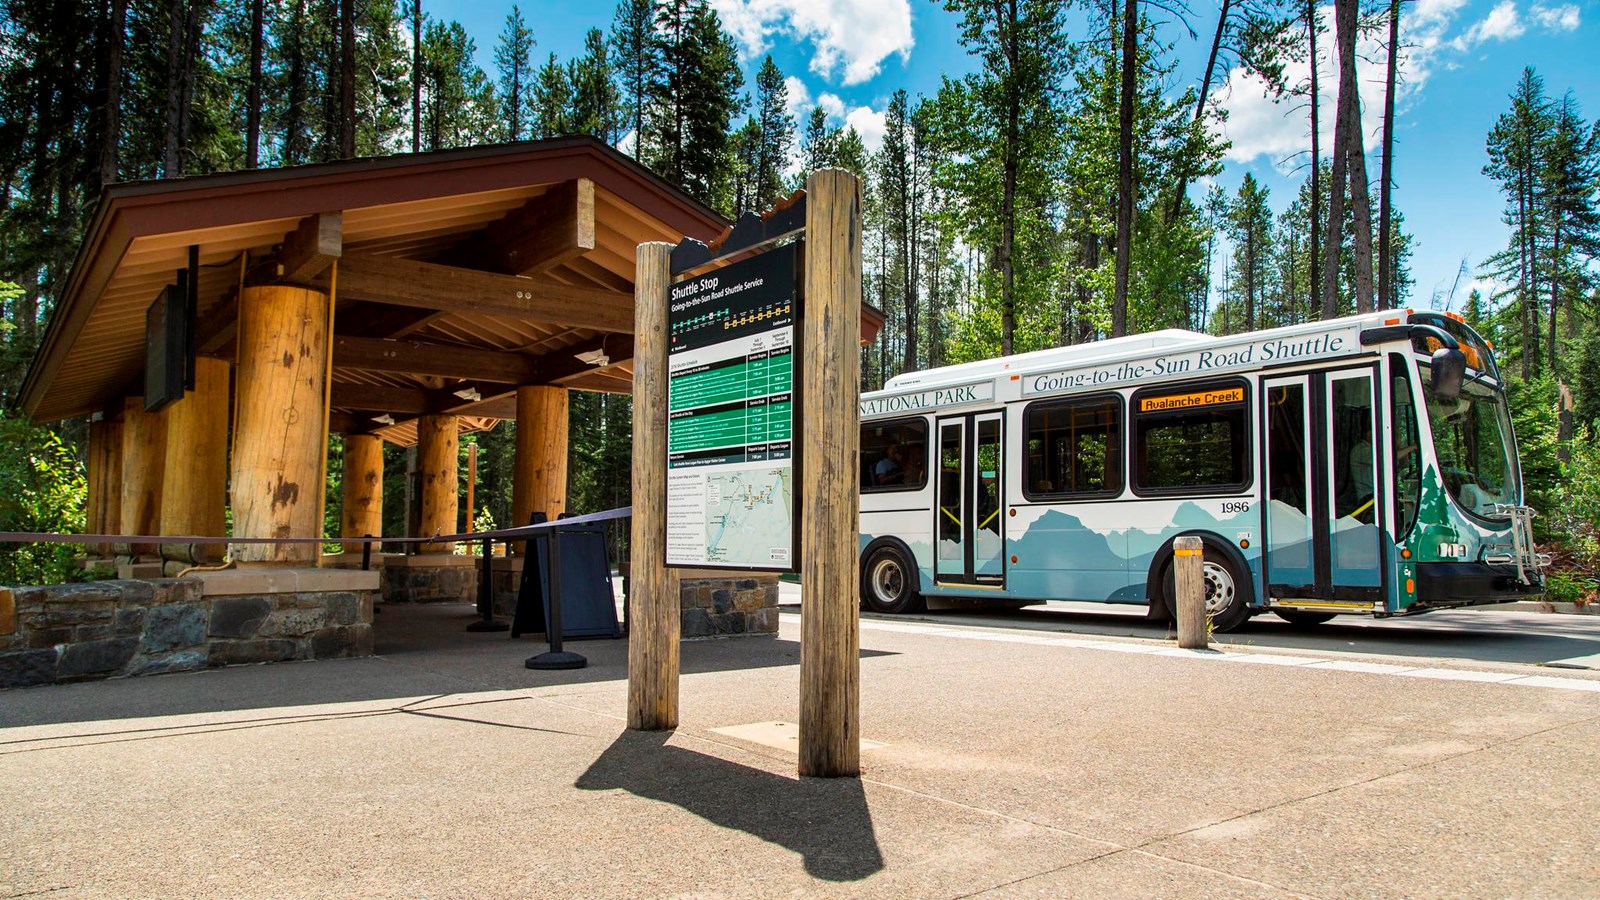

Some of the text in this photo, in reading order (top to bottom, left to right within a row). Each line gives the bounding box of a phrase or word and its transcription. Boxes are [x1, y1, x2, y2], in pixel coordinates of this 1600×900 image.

[671, 295, 710, 312] Going-to-the-Sun
[711, 290, 724, 300] Road
[725, 283, 743, 296] Shuttle
[744, 278, 764, 290] Service
[672, 277, 718, 300] Shuttle Stop
[1034, 334, 1343, 392] Going-to-the-Sun Road Shuttle
[860, 386, 977, 414] NATIONAL PARK
[1146, 391, 1239, 410] Avalanche Creek
[1221, 502, 1249, 513] 1986
